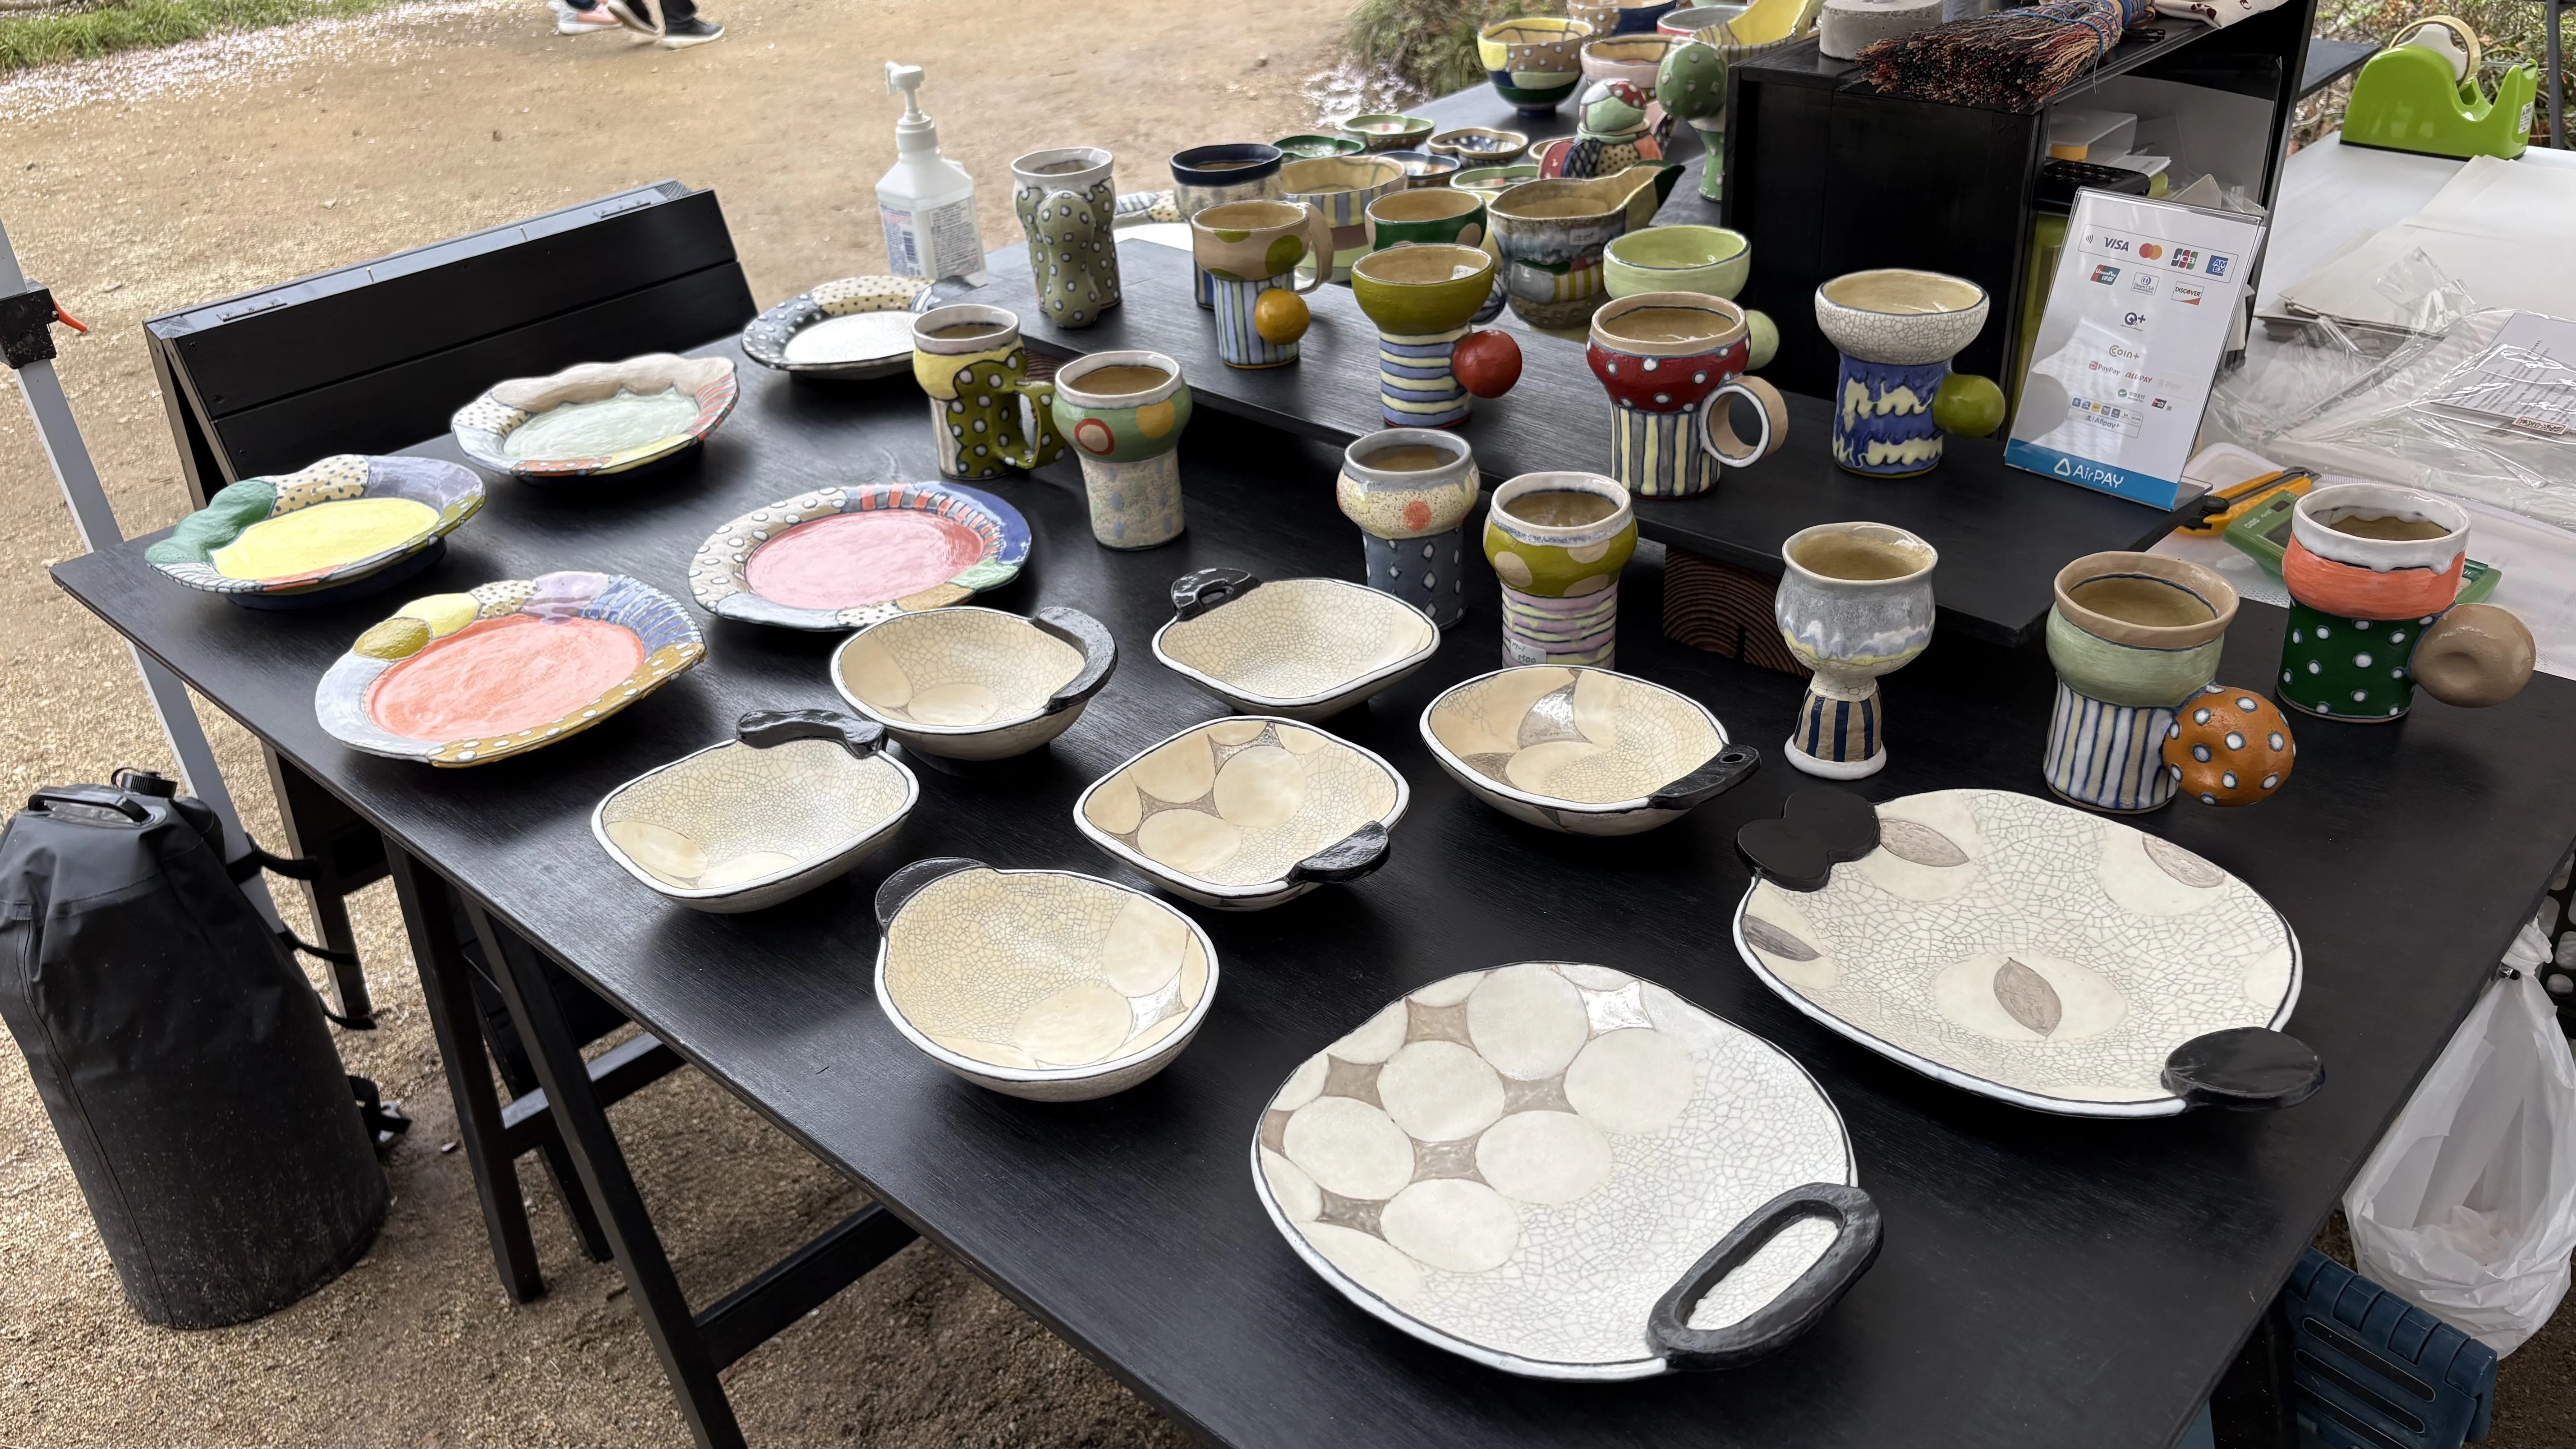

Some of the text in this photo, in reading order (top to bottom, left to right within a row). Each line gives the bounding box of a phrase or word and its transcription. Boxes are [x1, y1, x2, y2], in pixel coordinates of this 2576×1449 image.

[2104, 237, 2129, 252] VISA
[2172, 254, 2196, 265] JCB
[2212, 259, 2227, 268] AM
[2212, 266, 2225, 274] EX
[2175, 287, 2201, 297] DISCOVER
[2098, 363, 2121, 376] PayPay
[2139, 375, 2153, 384] PAY
[2073, 465, 2124, 488] AirPAY
[1518, 654, 1536, 663] 5500
